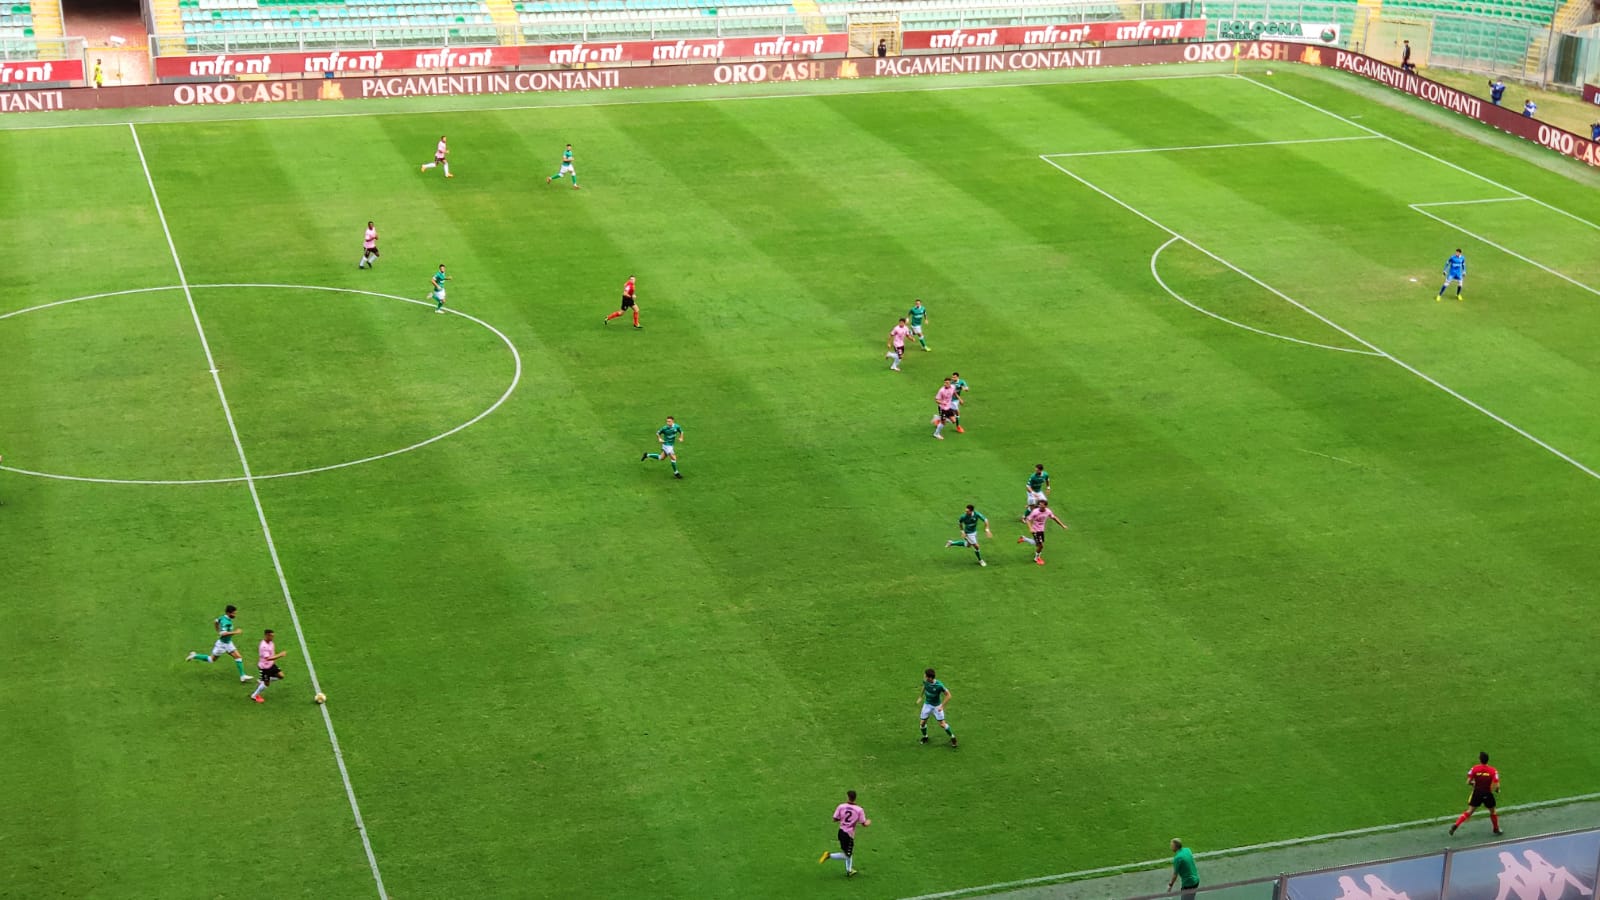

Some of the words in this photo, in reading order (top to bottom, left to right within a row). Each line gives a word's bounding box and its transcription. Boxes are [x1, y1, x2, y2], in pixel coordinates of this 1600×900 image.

[1219, 20, 1304, 36] BOLOGNA
[713, 62, 825, 83] OROCASH
[875, 55, 980, 76] PAGAMENTI
[985, 53, 1005, 71] IN
[1008, 49, 1101, 70] CONTANTI
[173, 82, 304, 104] OROCASH
[361, 75, 483, 97] PAGAMENTI
[488, 73, 510, 92] IN
[514, 70, 620, 91] CONTANTI
[1336, 50, 1404, 89] PAGAMENTI
[1405, 74, 1419, 95] IN
[1420, 80, 1481, 119] CONTANTI
[0, 91, 63, 111] TANTI
[844, 810, 853, 823] 2
